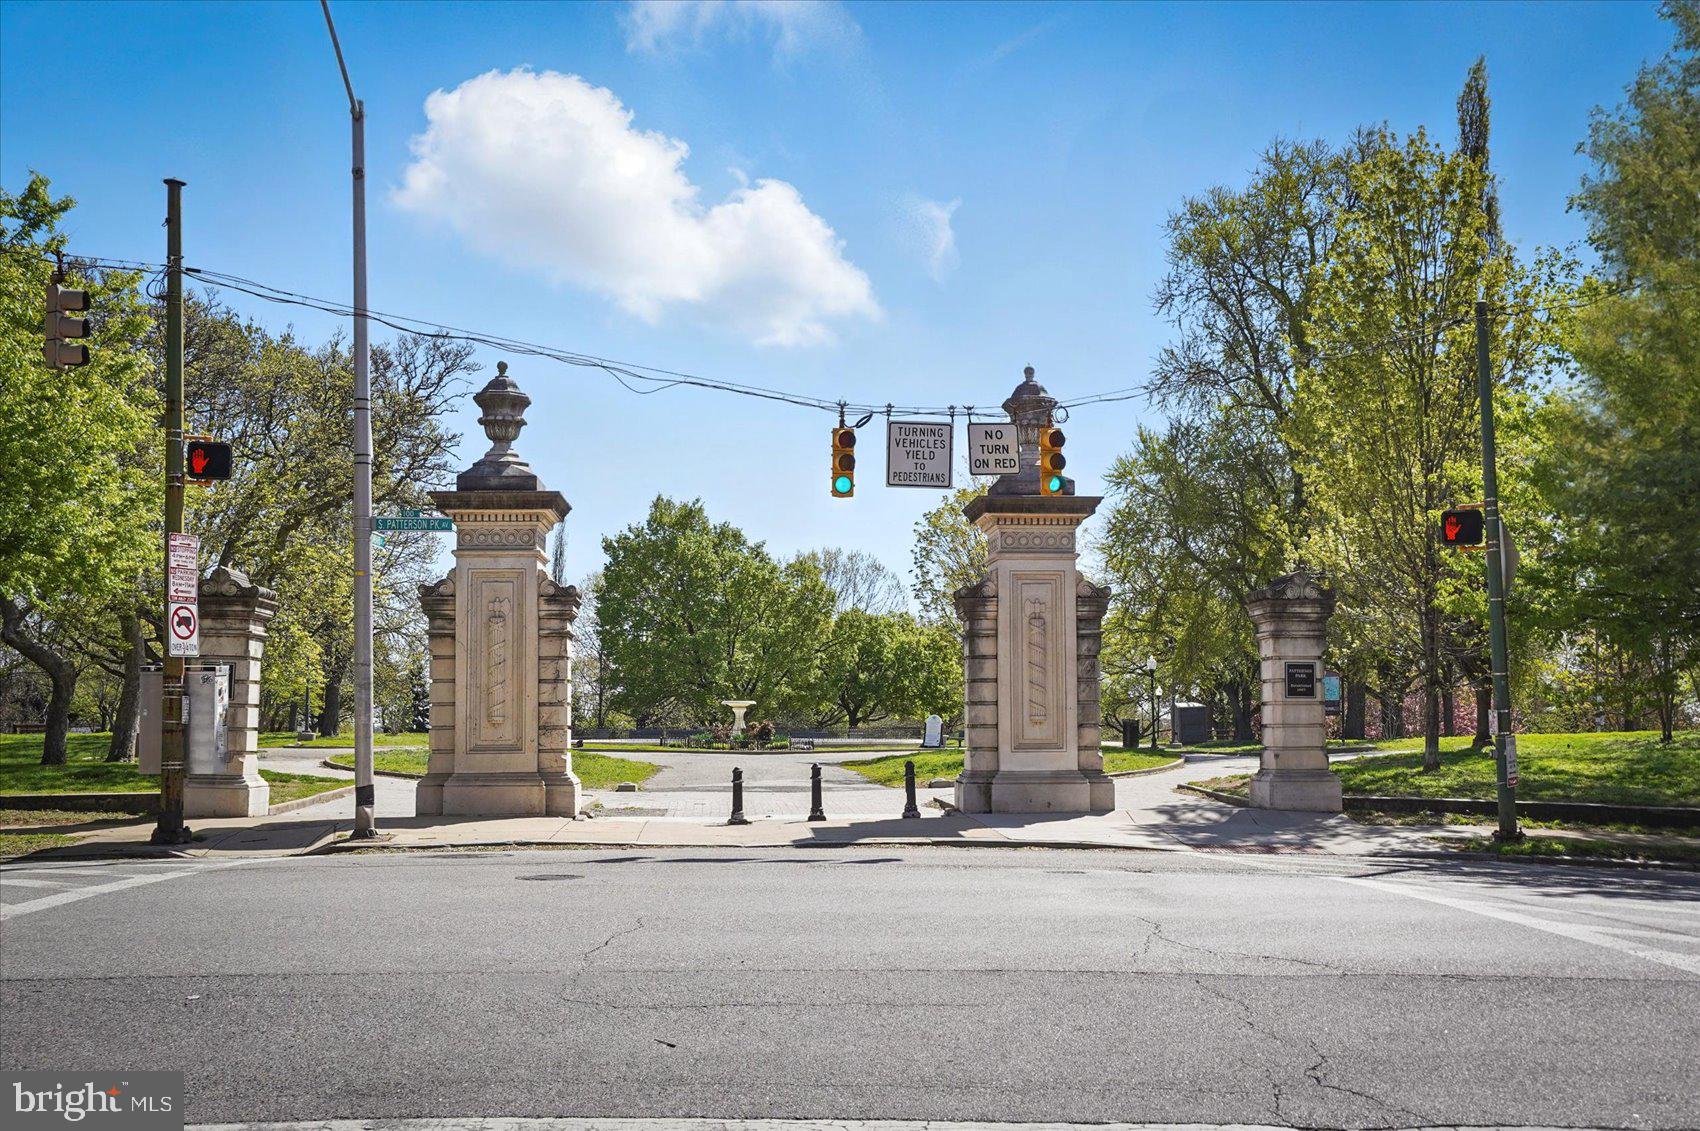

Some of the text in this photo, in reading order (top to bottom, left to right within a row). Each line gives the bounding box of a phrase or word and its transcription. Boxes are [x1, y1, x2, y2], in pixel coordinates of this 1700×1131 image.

[898, 427, 943, 437] TURNING
[984, 430, 1003, 440] NO
[895, 438, 946, 449] VEHICLES
[980, 444, 1009, 454] TURN
[905, 450, 935, 460] YIELD
[914, 462, 925, 471] TO
[974, 458, 1016, 469] ON RED
[893, 471, 946, 483] PEDESTRIANS
[377, 519, 385, 530] S.
[386, 519, 427, 529] PATTERSON
[171, 642, 182, 651] OVER
[189, 643, 197, 651] TON
